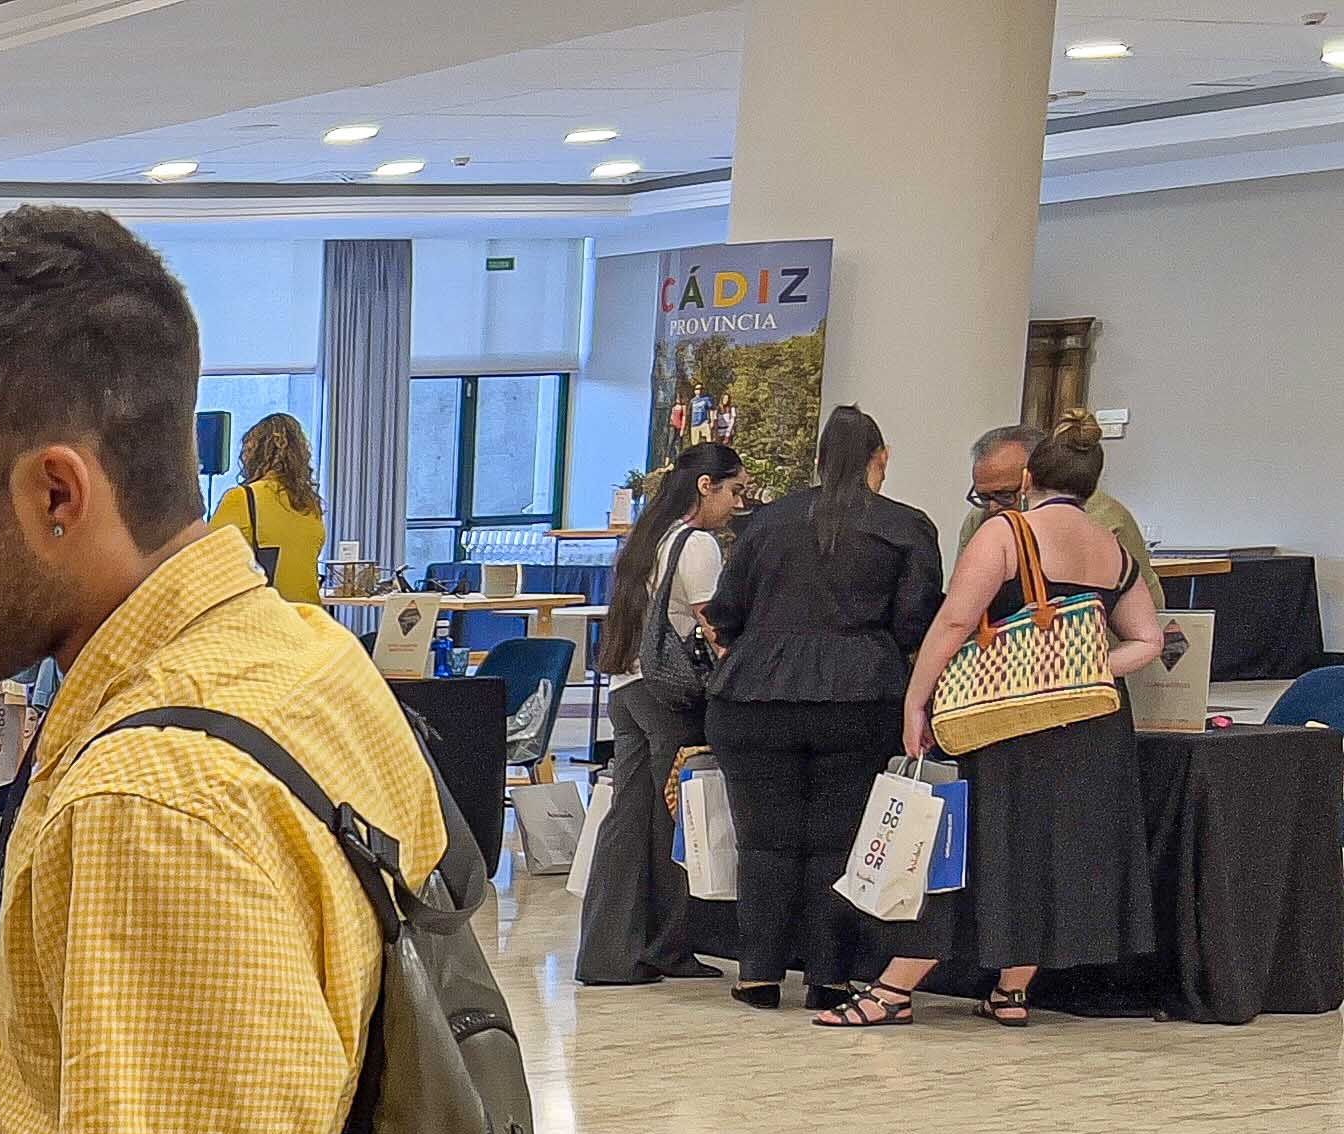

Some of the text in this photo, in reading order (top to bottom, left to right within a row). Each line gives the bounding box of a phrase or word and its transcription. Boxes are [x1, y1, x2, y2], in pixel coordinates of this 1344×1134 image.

[661, 265, 810, 313] CÁDIZ
[670, 313, 778, 336] PROVINCIA
[889, 798, 904, 814] TO
[882, 812, 899, 828] DO
